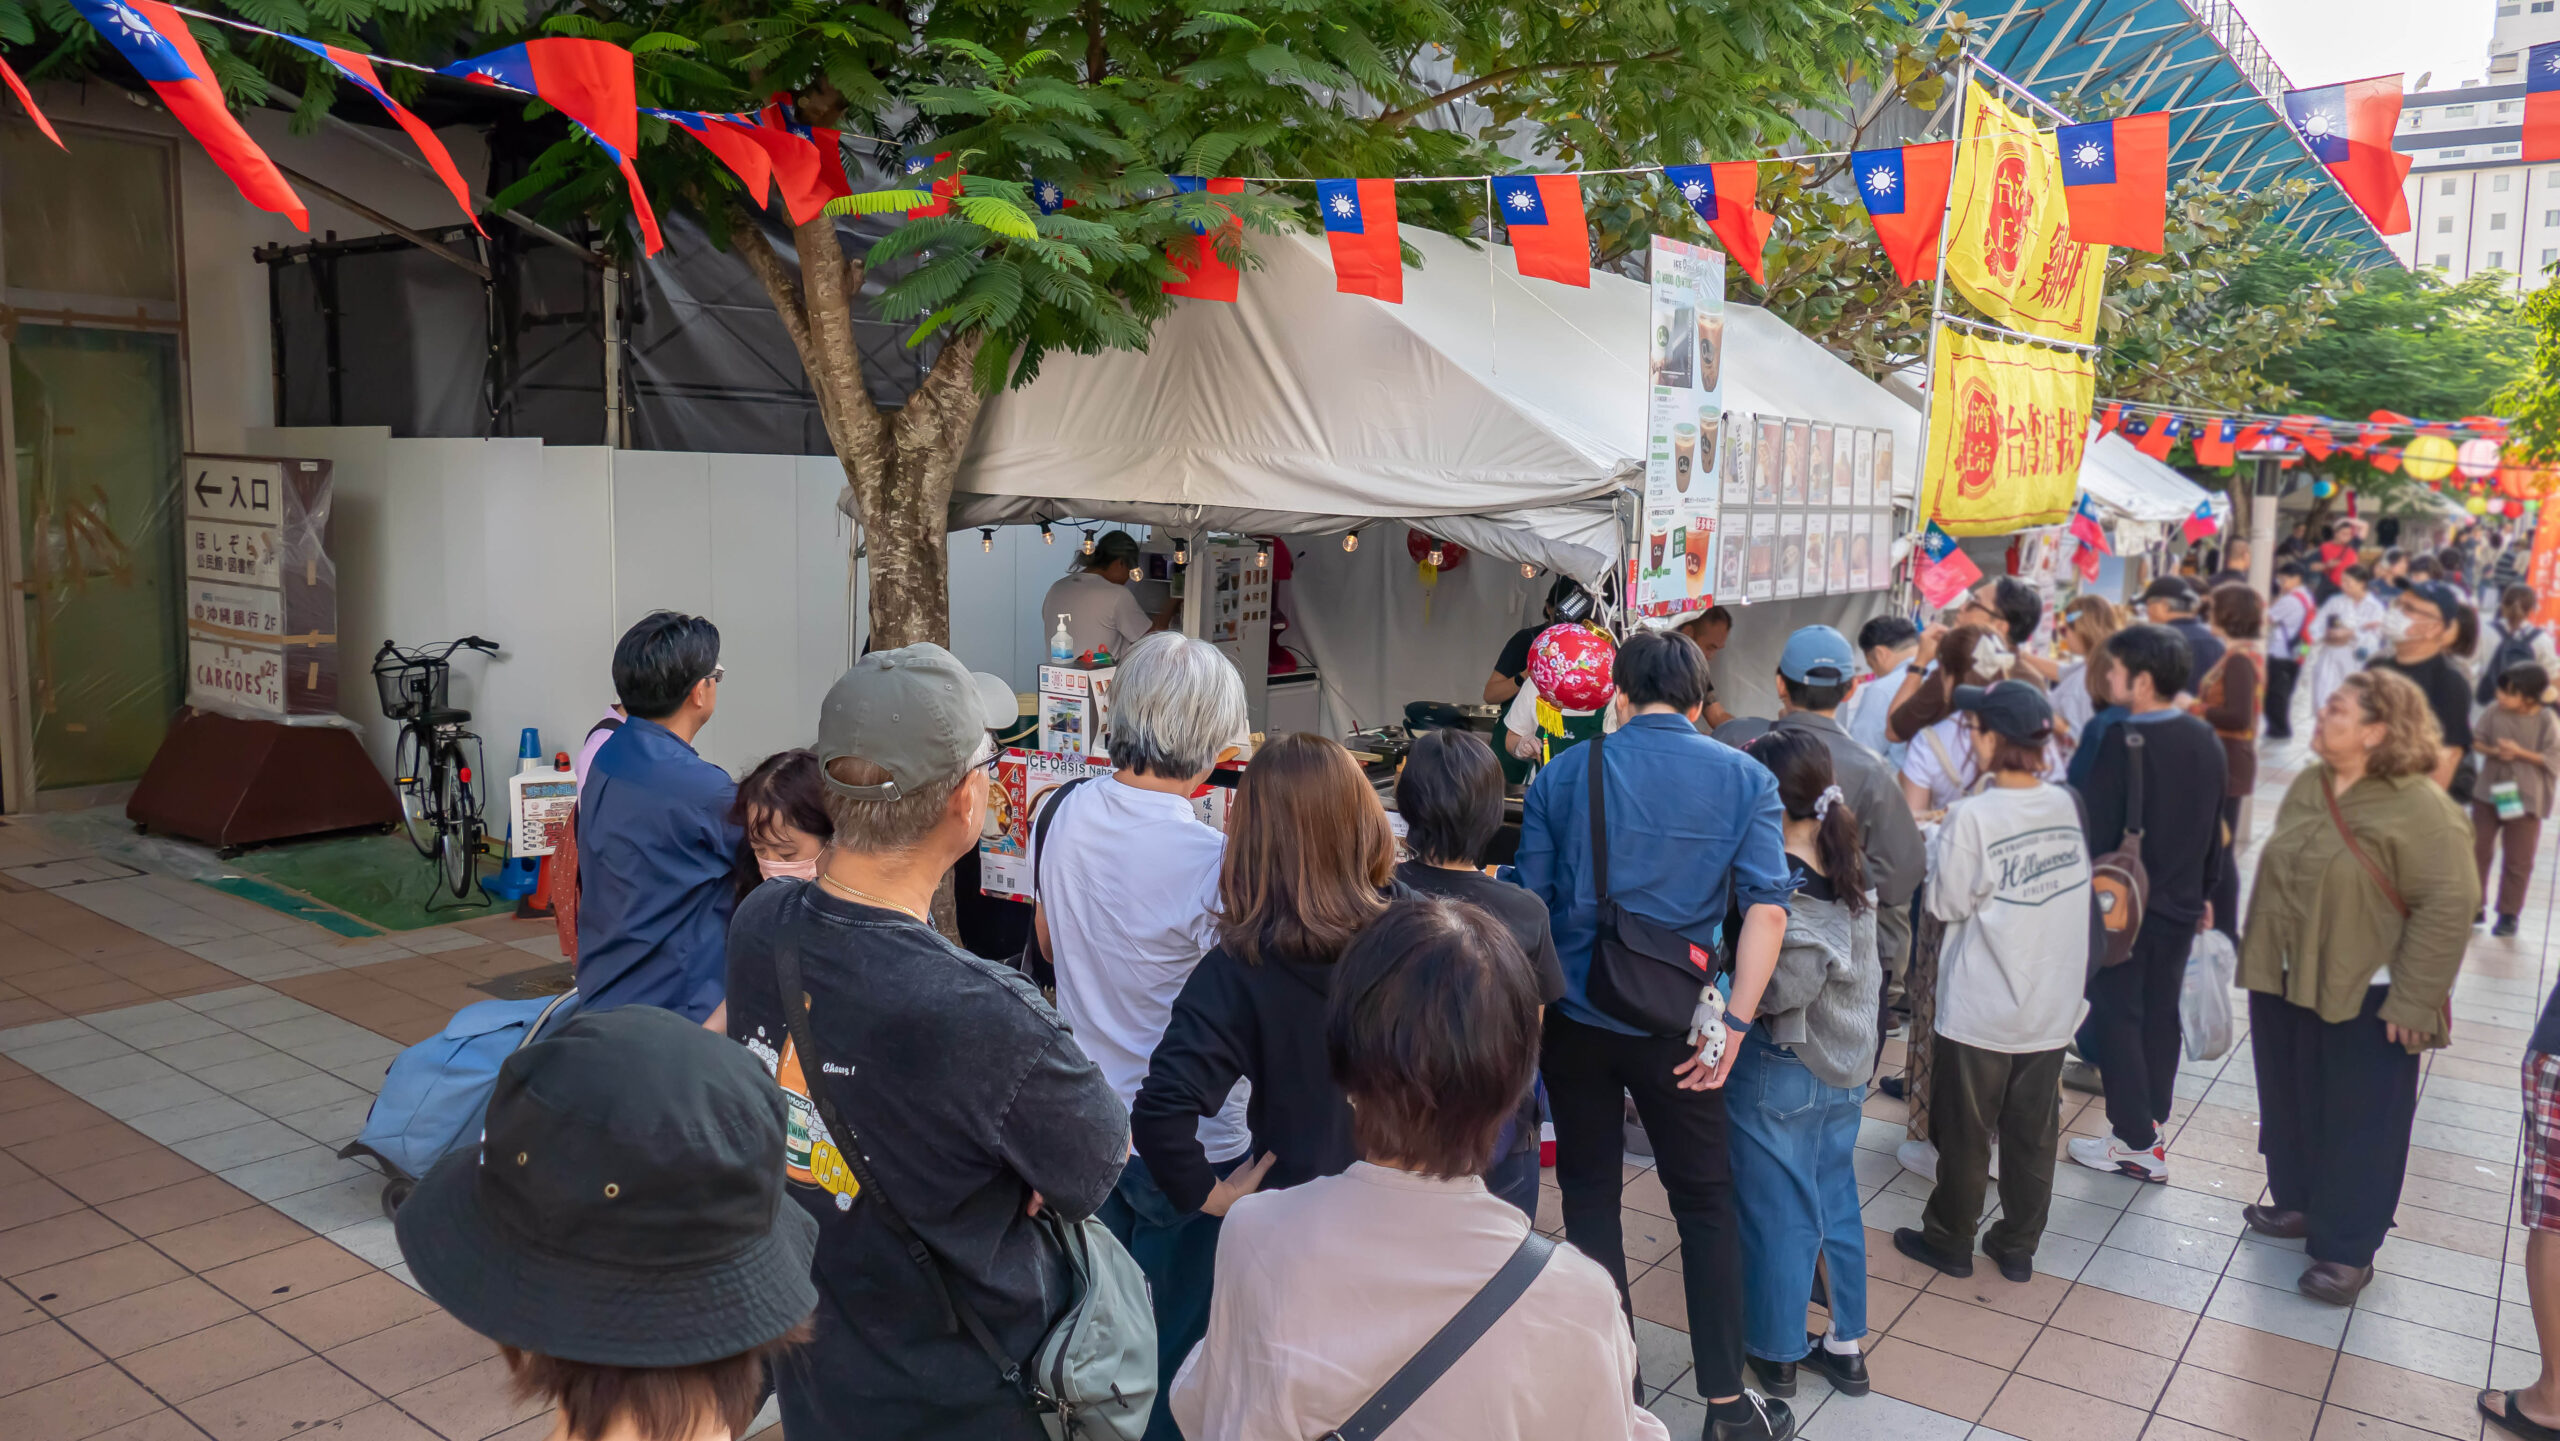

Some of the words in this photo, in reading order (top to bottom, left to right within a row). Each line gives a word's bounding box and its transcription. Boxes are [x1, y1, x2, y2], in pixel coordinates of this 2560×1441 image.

[229, 476, 269, 511] 入口
[196, 531, 258, 559] ほしぞら
[207, 606, 259, 629] 沖縄銀行
[264, 614, 277, 631] 2F
[197, 664, 262, 695] CARGOES
[264, 660, 278, 677] 2F
[266, 687, 279, 705] 1F
[1026, 754, 1047, 769] ICE
[1050, 756, 1086, 773] Oasis
[1998, 844, 2080, 891] Hollywood
